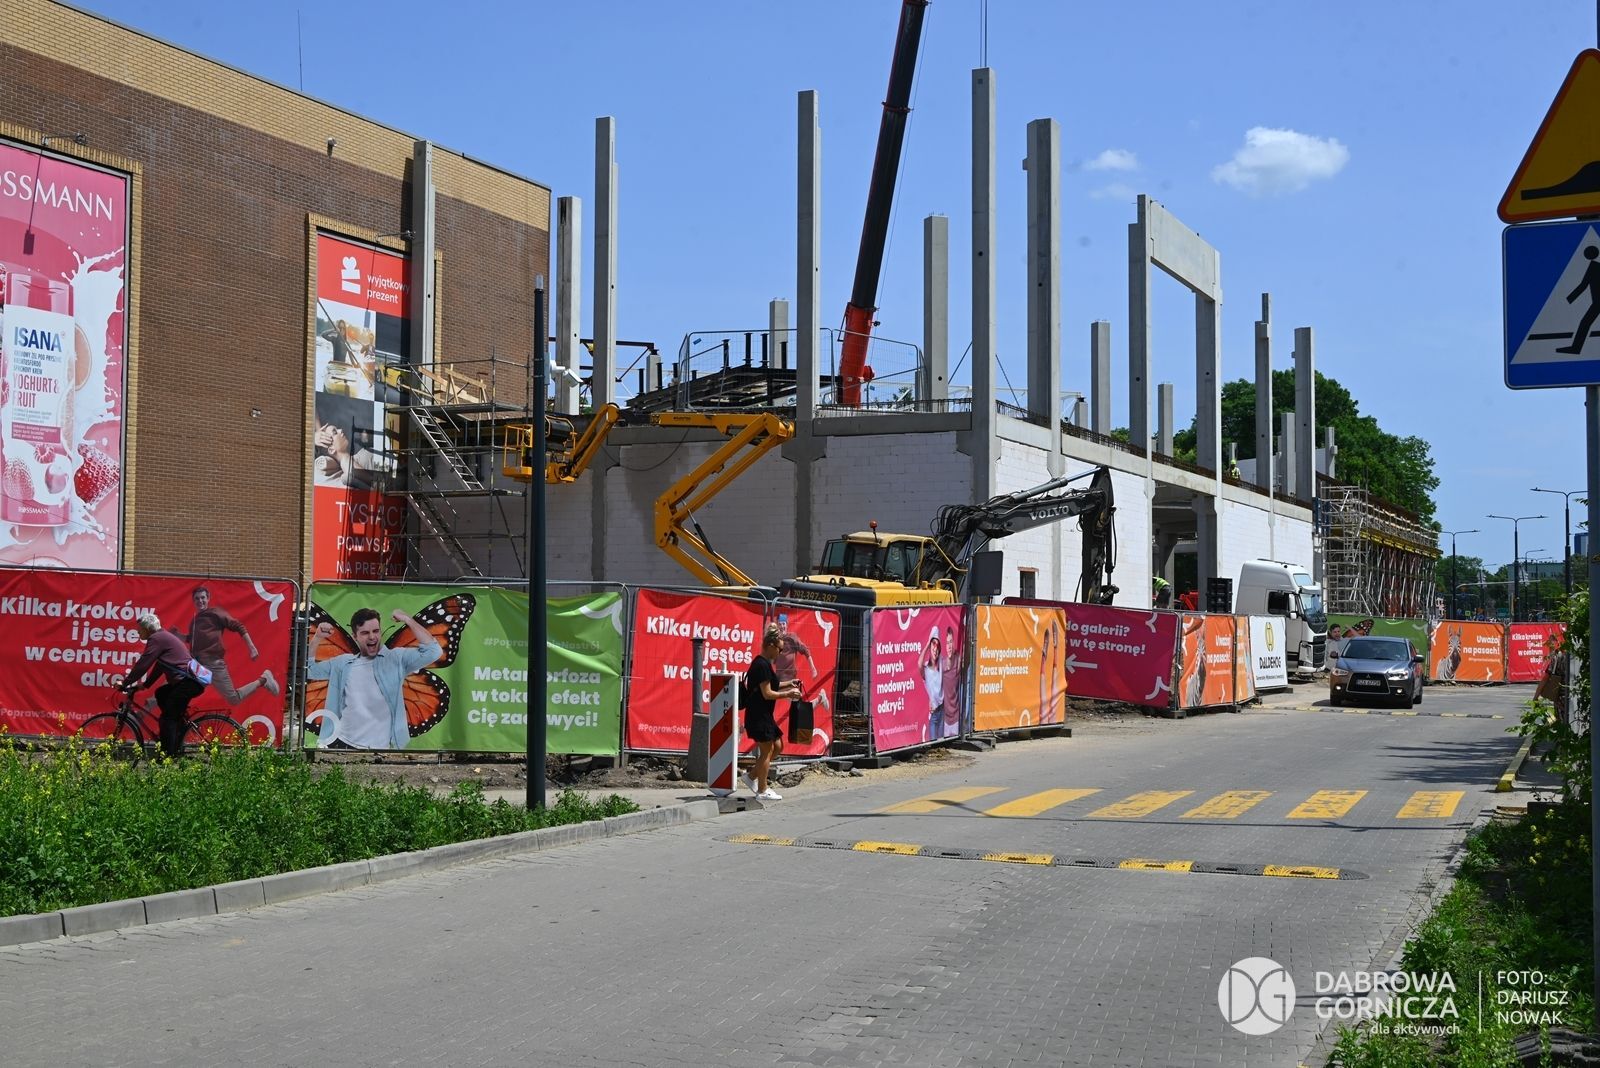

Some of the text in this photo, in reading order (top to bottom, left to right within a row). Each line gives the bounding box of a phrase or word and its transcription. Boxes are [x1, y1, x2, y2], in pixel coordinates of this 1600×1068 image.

[0, 170, 113, 222] SSMANN
[367, 273, 410, 294] wyjątkowy
[367, 288, 399, 304] prezent
[14, 326, 62, 352] ISANA
[13, 372, 53, 393] YOGHURT
[1029, 505, 1070, 521] VOLVO
[1, 595, 156, 621] Kilka kroków
[71, 620, 147, 647] i jeste
[646, 615, 755, 644] Kilka kroków
[1080, 624, 1130, 638] galerii?
[25, 646, 46, 662] w
[702, 641, 754, 666] jesteś
[876, 641, 922, 655] Krok w stronę
[1017, 647, 1033, 662] buty?
[1070, 638, 1146, 657] w tę stronę!
[1463, 647, 1501, 656] na pasach!
[474, 666, 600, 684] Metarfoza
[663, 664, 678, 680] w
[877, 660, 904, 677] nowych
[980, 665, 998, 676] Zaraz
[877, 678, 915, 695] modowych
[979, 680, 1003, 694] nowe!
[471, 690, 487, 703] w
[551, 689, 600, 706] efekt
[877, 697, 905, 715] odkryć!
[467, 708, 599, 731] Cię zawyci!
